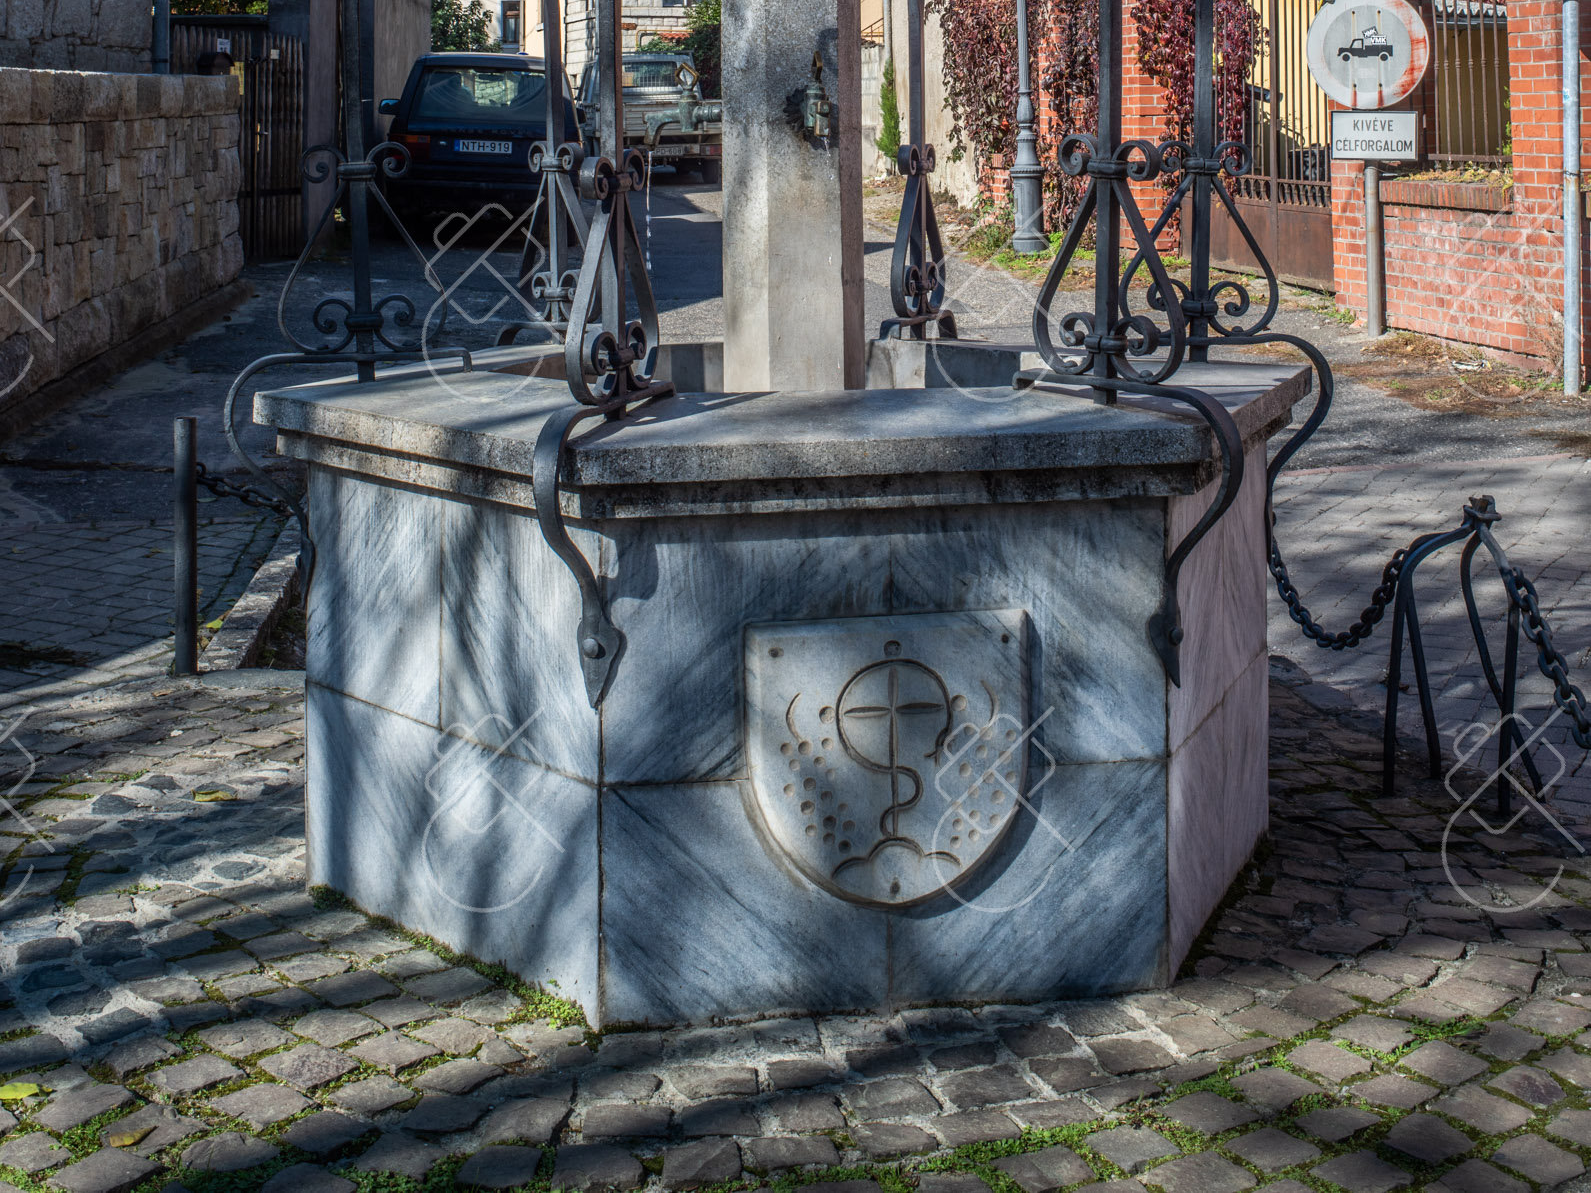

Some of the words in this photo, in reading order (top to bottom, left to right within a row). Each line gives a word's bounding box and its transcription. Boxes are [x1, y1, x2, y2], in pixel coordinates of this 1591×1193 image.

[1353, 117, 1394, 132] KIVÉVE
[461, 141, 511, 153] NTH-919
[1335, 138, 1413, 152] CÉLFORGALOM
